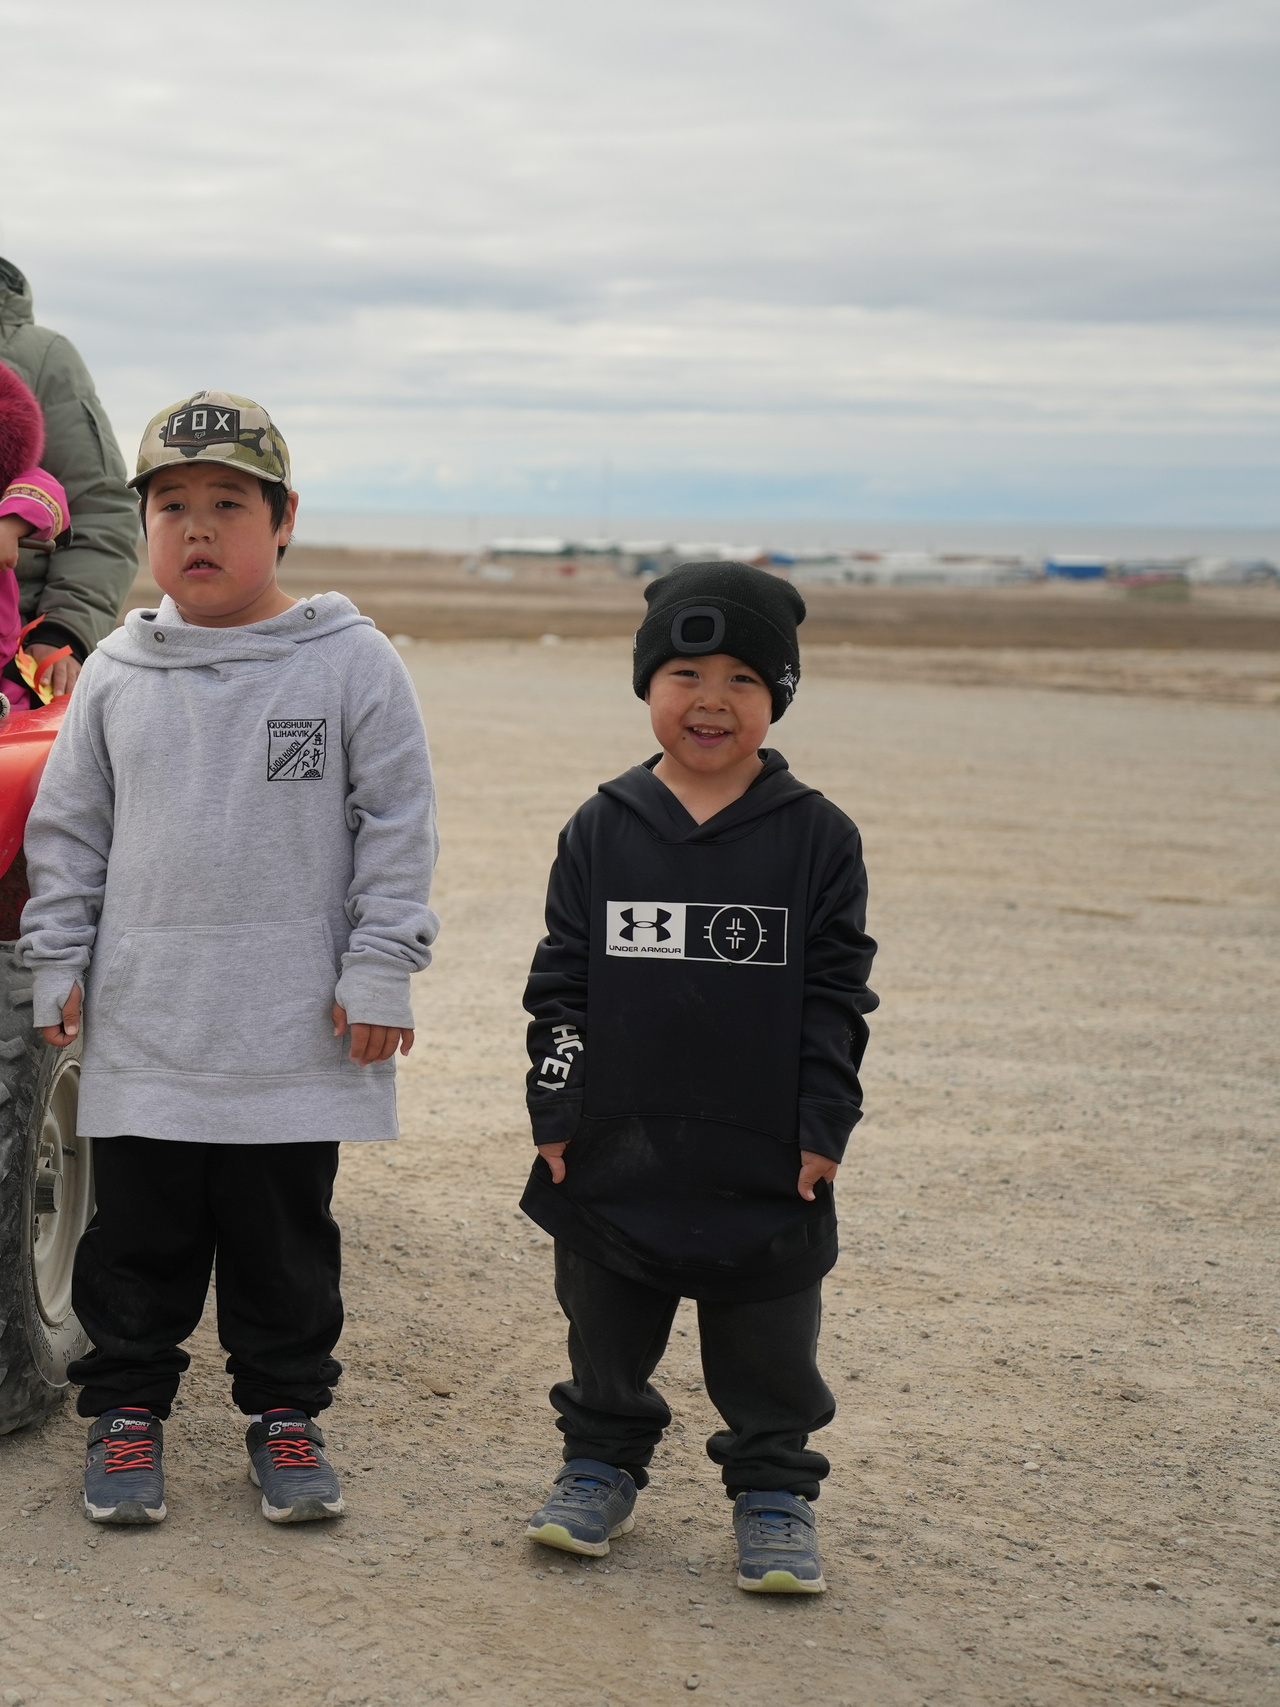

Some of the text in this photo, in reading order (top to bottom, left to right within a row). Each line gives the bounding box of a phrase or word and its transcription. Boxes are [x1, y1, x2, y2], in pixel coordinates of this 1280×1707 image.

[172, 410, 231, 436] FOX
[268, 740, 301, 773] GJOA HAVEN
[641, 946, 682, 954] ARMOUR
